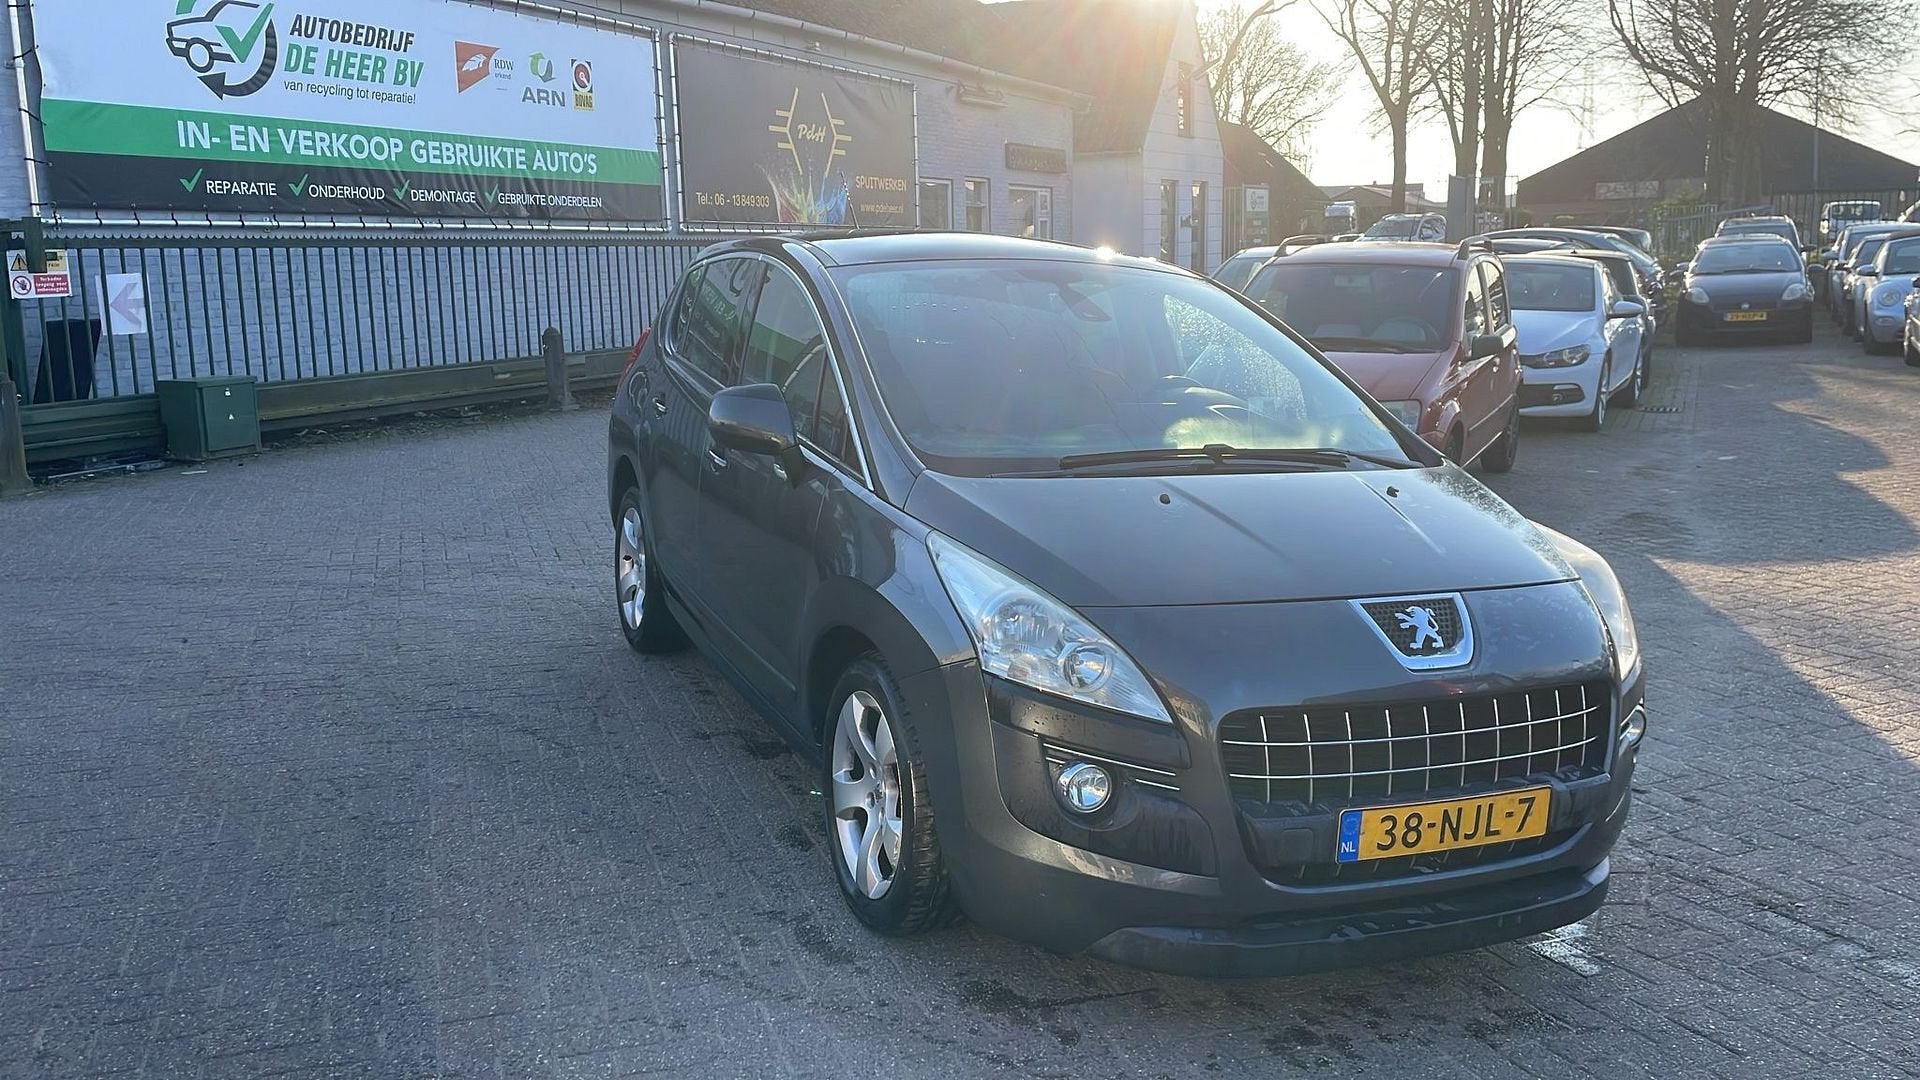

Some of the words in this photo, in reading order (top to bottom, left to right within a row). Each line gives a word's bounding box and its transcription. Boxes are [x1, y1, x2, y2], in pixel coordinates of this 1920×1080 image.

[290, 14, 415, 52] AUTOBEDRIJF
[284, 43, 318, 75] DE
[325, 49, 388, 84] HEER
[393, 58, 424, 88] BV
[494, 58, 514, 71] RDW
[284, 80, 303, 92] van
[306, 84, 354, 100] recycling
[356, 88, 370, 99] tot
[371, 92, 416, 104] reparatie!
[522, 86, 566, 107] ARN
[177, 120, 221, 149] IN-
[229, 124, 270, 153] EN
[277, 128, 404, 162] VERKOOP
[410, 139, 527, 170] GEBRUIKTE
[532, 150, 598, 175] AUTO'S
[206, 180, 277, 196] REPARATIE
[855, 175, 907, 192] SPUITWERKEN
[308, 184, 385, 200] ONDERHOUD
[411, 189, 476, 204] DEMONTAGE
[498, 192, 546, 206] GEBRUIKTE
[549, 194, 602, 208] ONDERDELEN
[695, 192, 713, 205] Tel.:
[714, 193, 725, 206] 06
[1376, 797, 1536, 851] 38-NJL-7
[1341, 841, 1356, 853] NL
